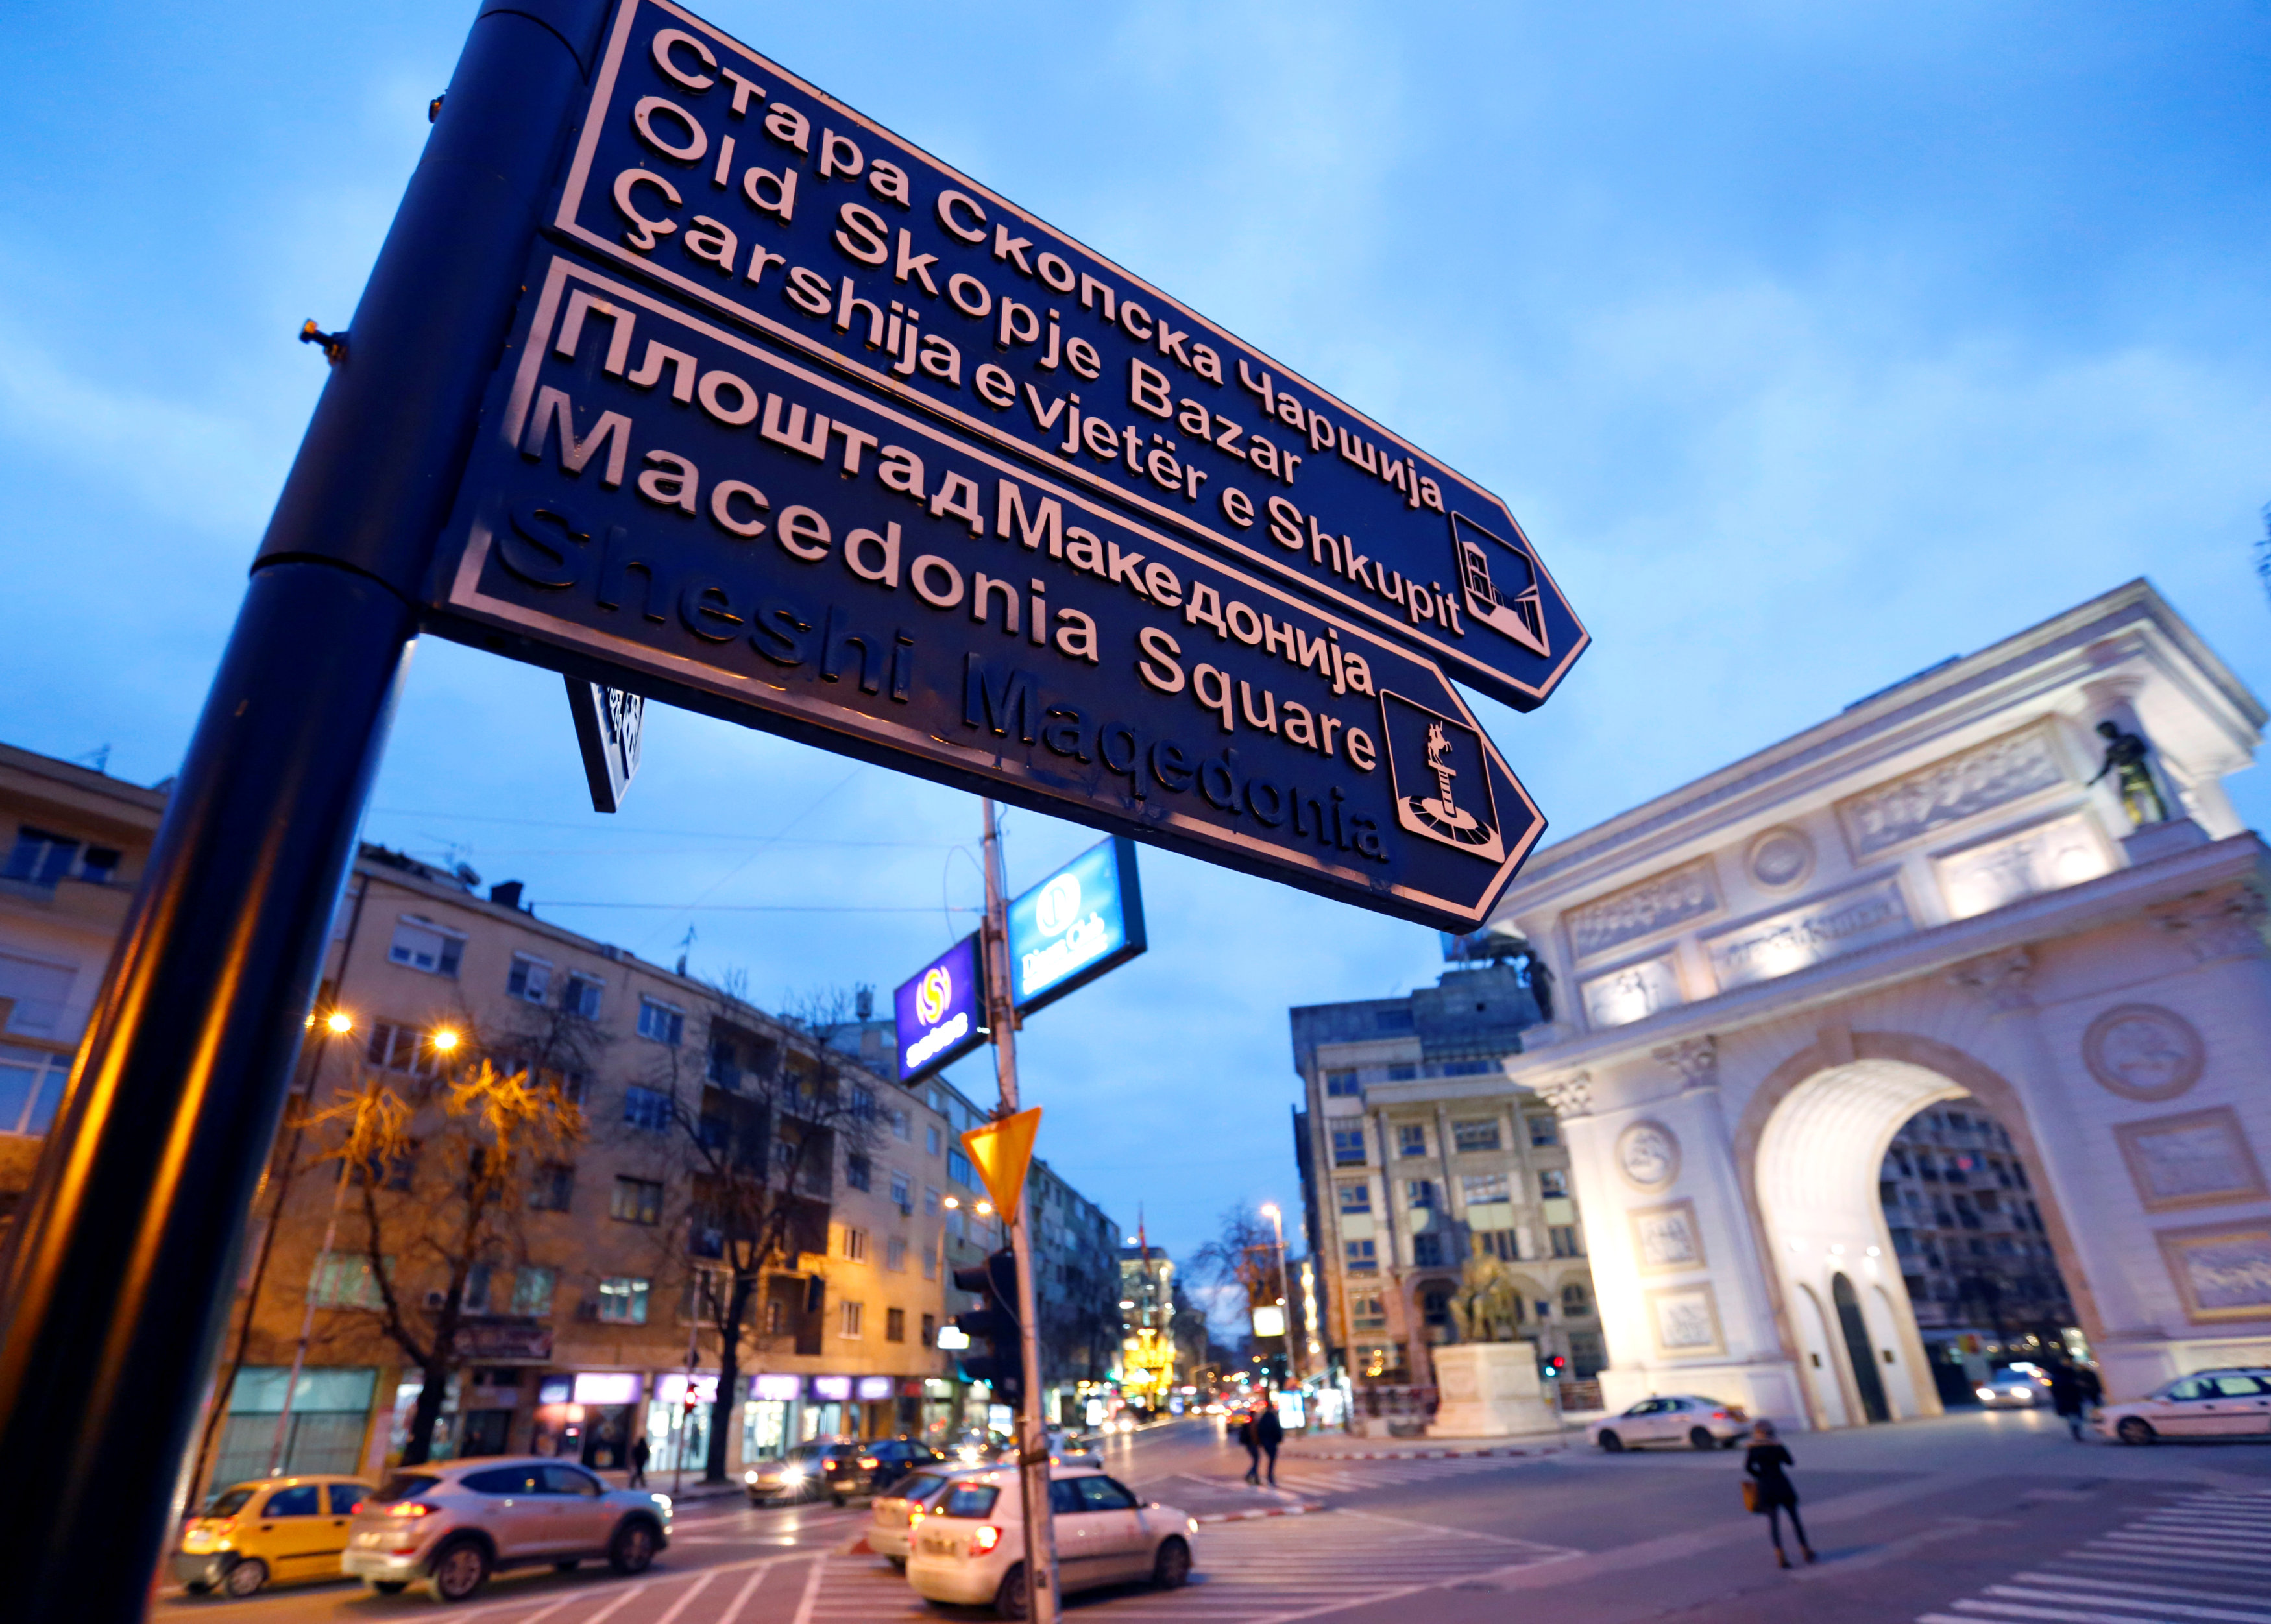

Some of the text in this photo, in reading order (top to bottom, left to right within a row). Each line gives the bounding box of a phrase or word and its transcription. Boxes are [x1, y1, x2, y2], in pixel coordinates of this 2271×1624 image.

[613, 168, 1464, 635] Çarshija e vjetër e Shkupit
[634, 96, 1302, 483] Old Skopje Bazar
[653, 29, 1445, 513] Стара Скопска Чаршија
[498, 497, 1389, 862] Sheshi Maqedonia
[524, 386, 1377, 770] Macedonia Square
[555, 289, 1376, 697] Плоштад Македонија
